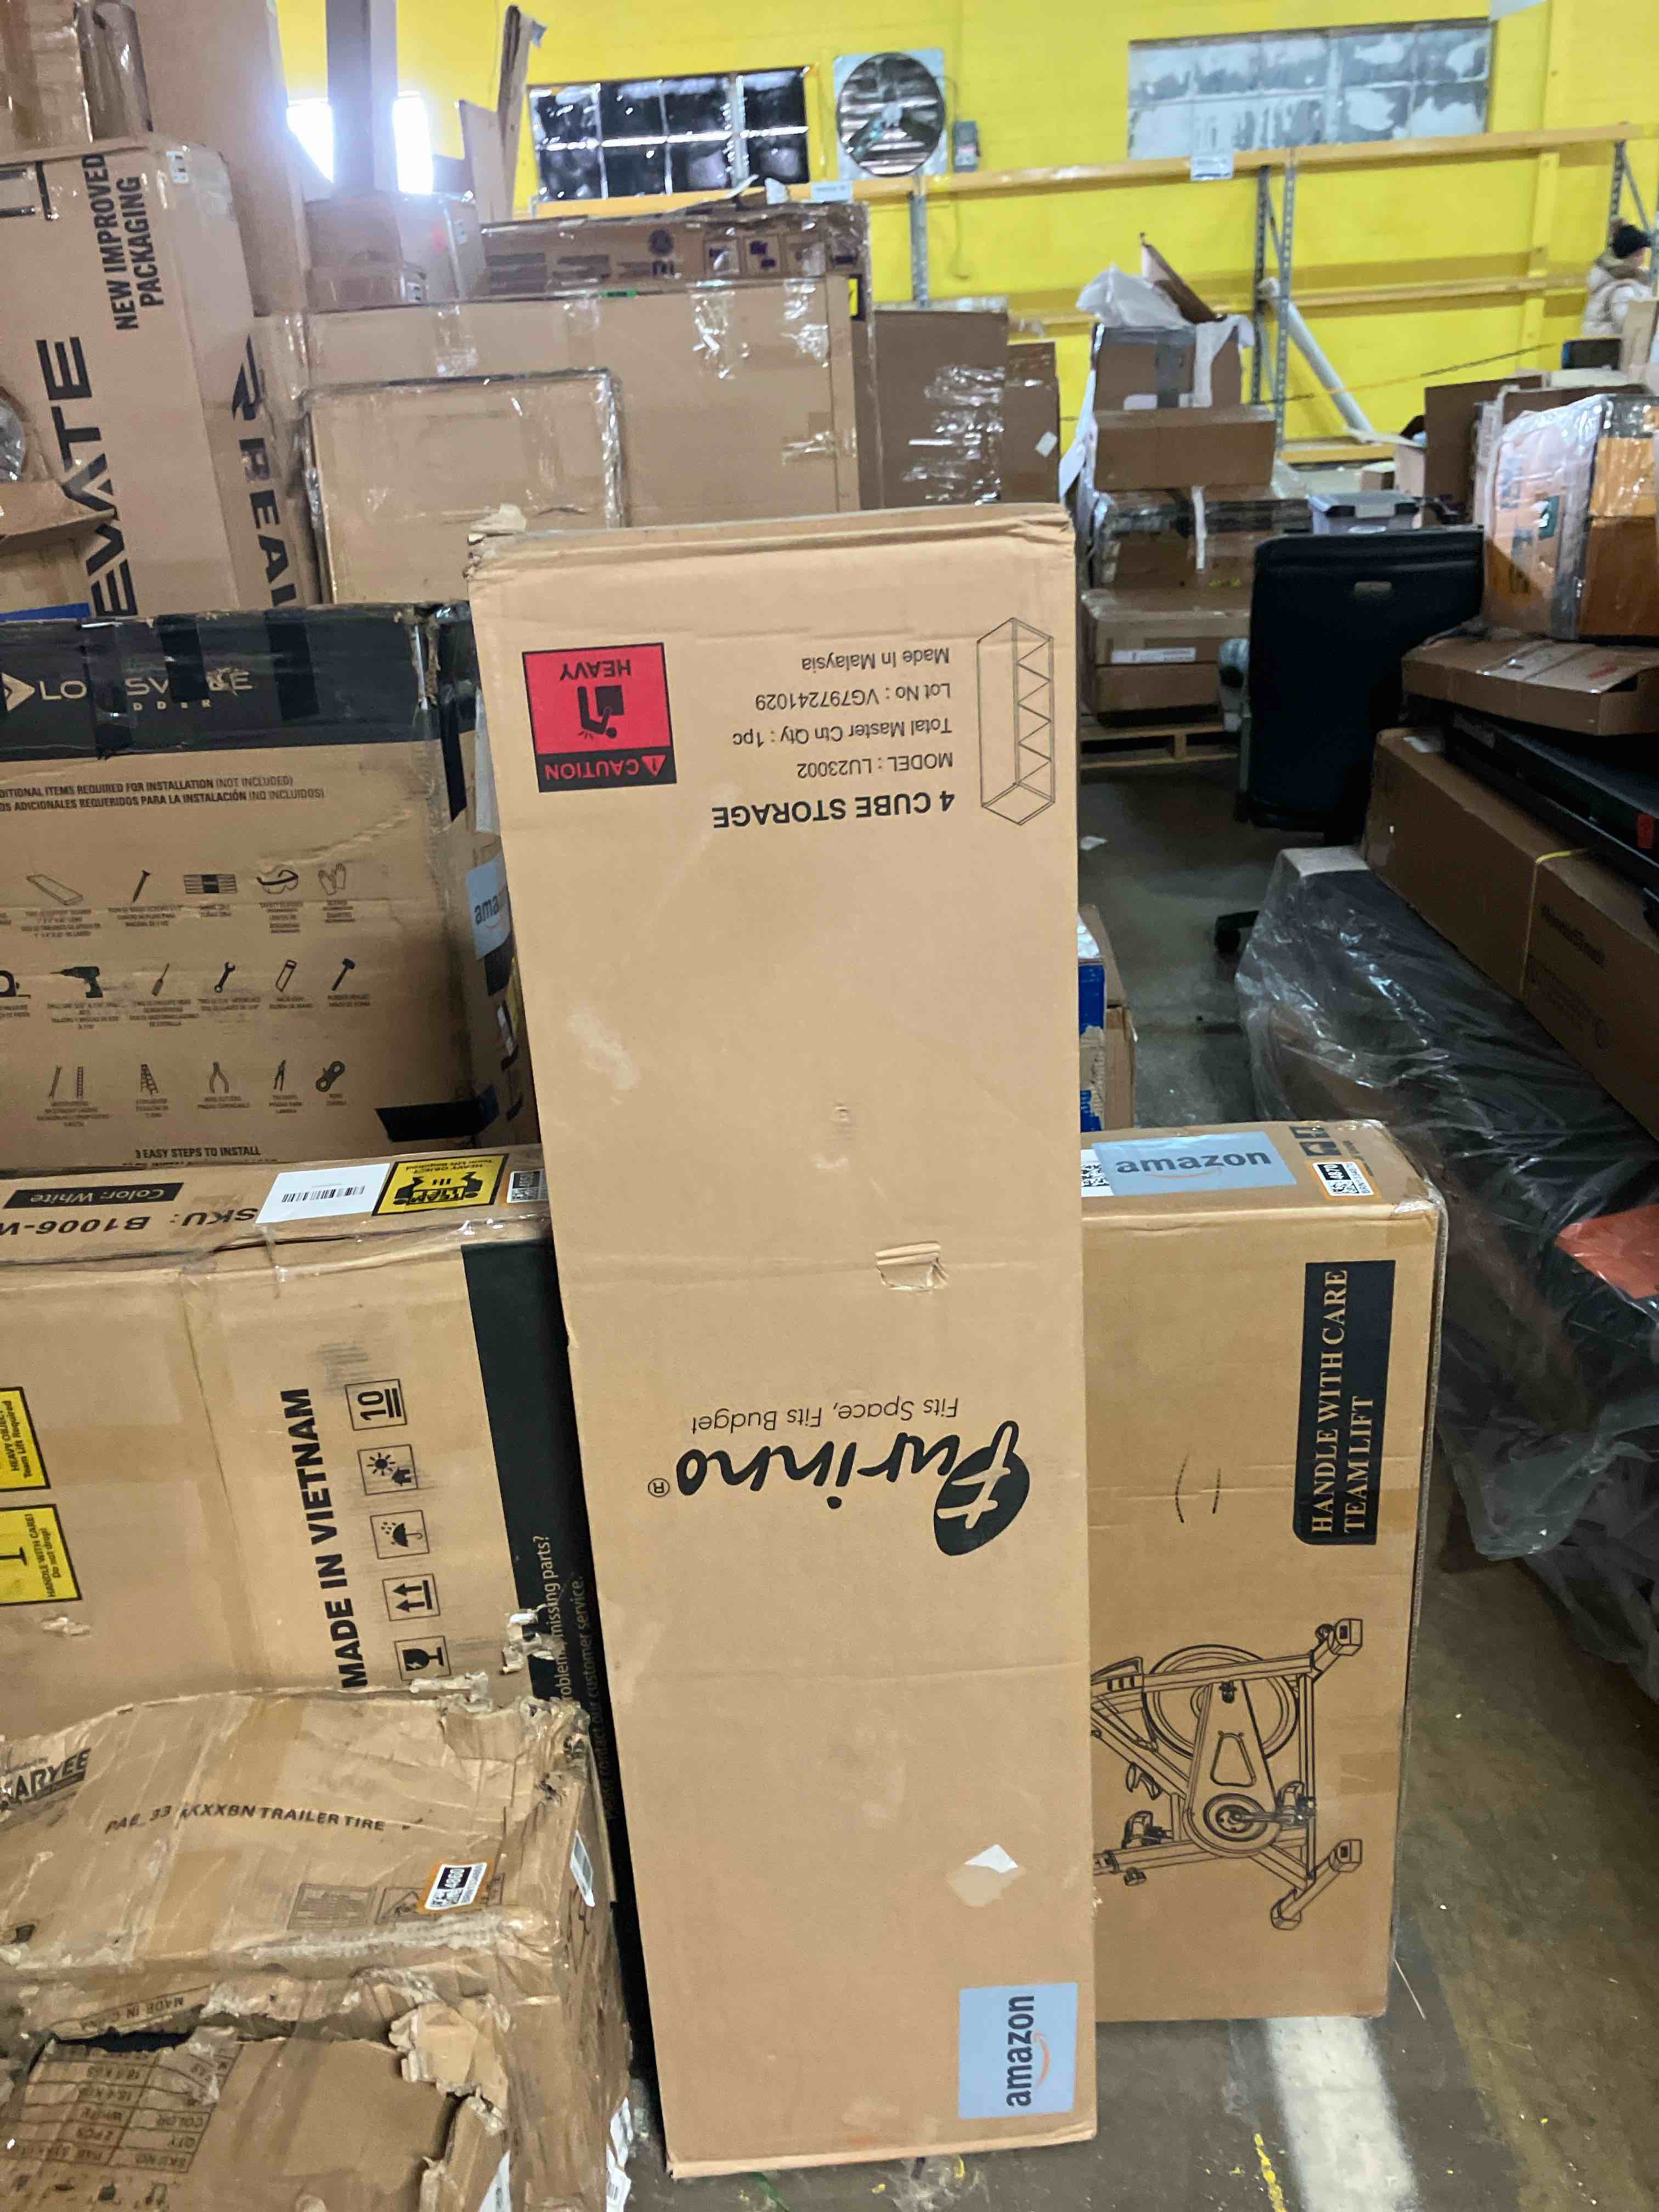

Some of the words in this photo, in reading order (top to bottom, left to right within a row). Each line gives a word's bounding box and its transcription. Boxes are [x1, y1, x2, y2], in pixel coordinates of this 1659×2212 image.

[81, 154, 127, 274] IMPROVED
[117, 176, 165, 307] PACKAGING
[110, 279, 139, 331] NEW
[801, 652, 876, 673] Malaysia
[881, 651, 896, 666] In
[902, 647, 950, 665] Made
[560, 659, 631, 681] HEAVY
[755, 689, 879, 710] VG797241029
[895, 686, 919, 702] No
[924, 683, 951, 699] Lot
[732, 728, 764, 748] 1pc
[780, 726, 809, 745] Qty
[815, 726, 843, 742] Ctn
[848, 720, 905, 738] Master
[911, 718, 953, 735] Total
[544, 758, 640, 781] CAUTION
[797, 759, 873, 779] LU23002
[887, 752, 953, 772] MODEL
[44, 786, 75, 797] ITEMS
[77, 783, 123, 795] REQUIRED
[125, 782, 144, 793] FOR
[145, 778, 214, 792] INSTALLATION
[216, 777, 240, 789] (NOT
[241, 775, 294, 787] INCLUDED)
[14, 799, 77, 812] ADICIONALES
[79, 797, 139, 809] REQUERIDOS
[140, 794, 167, 806] PARA
[168, 793, 181, 804] LA
[183, 789, 247, 803] INSTALACIÓN
[249, 789, 267, 800] (NO
[268, 788, 325, 800] INCLUIDOS)
[854, 792, 932, 819] CUBE
[939, 790, 956, 812] 4
[712, 798, 847, 829] STORAGE
[135, 1149, 141, 1159] 3
[143, 1149, 168, 1159] EASY
[172, 1148, 202, 1158] STEPS
[205, 1147, 218, 1157] TO
[220, 1146, 261, 1156] INSTALL
[1115, 1149, 1272, 1175] amazon
[30, 1192, 93, 1204] White
[103, 1188, 165, 1200] Color:
[170, 1207, 259, 1227] SKU:
[1322, 1269, 1348, 1346] CARE
[1317, 1351, 1344, 1423] WITH
[786, 1407, 822, 1428] Fits
[833, 1397, 913, 1420] Space,
[923, 1397, 960, 1418] Fits
[2, 1400, 22, 1440] Required
[691, 1408, 777, 1435] Budget
[1348, 1395, 1374, 1454] LIFT
[14, 1439, 25, 1454] Lift
[5, 1448, 19, 1472] HEAVY
[20, 1455, 32, 1478] Team
[280, 1387, 338, 1546] VIETNAM
[676, 1420, 1030, 1554] Furinno
[1311, 1429, 1339, 1534] HANDLE
[1344, 1459, 1370, 1533] TEAM
[24, 1513, 39, 1539] CARE!
[40, 1527, 54, 1549] drop!
[32, 1541, 46, 1565] WITH
[47, 1549, 58, 1566] not
[532, 1536, 554, 1579] parts?
[37, 1565, 56, 1598] HANDLE
[51, 1566, 62, 1578] Do
[315, 1553, 348, 1589] IN
[544, 1581, 564, 1644] missing
[570, 1575, 591, 1630] service.
[324, 1598, 368, 1689] MADE
[579, 1632, 600, 1699] customer
[259, 1807, 340, 1826] TRAILER
[343, 1815, 385, 1832] TIRE
[146, 1996, 184, 2011] MADE
[1006, 1995, 1035, 2107] amazon
[157, 2115, 204, 2128] COLOR
[167, 2135, 195, 2148] QTY
